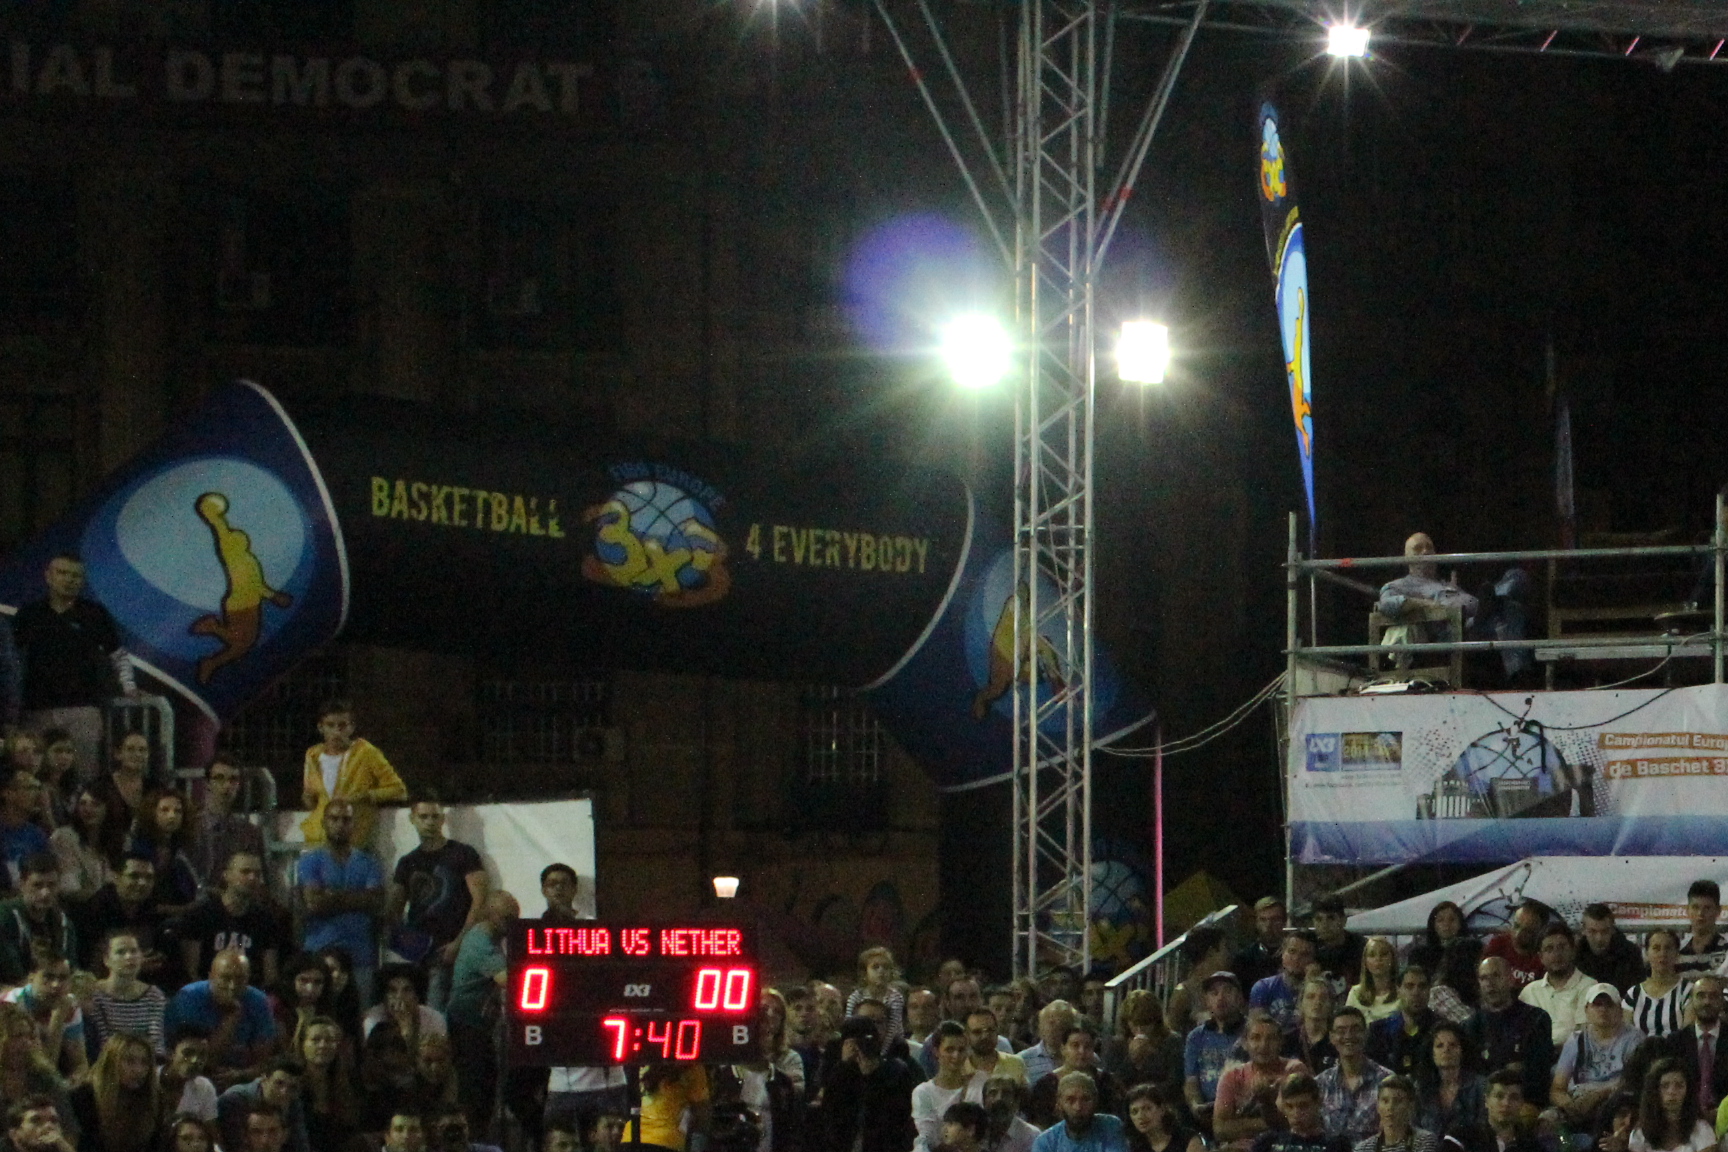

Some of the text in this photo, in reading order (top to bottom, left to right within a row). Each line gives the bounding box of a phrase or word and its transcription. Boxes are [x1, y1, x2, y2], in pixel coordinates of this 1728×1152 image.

[164, 50, 594, 114] DEMOCRAT
[370, 476, 567, 538] BASKETBALL
[745, 522, 930, 574] 4 EVERYBODY
[1604, 733, 1689, 748] Campionatul
[1609, 761, 1632, 777] de
[1637, 759, 1710, 775] Baschet
[527, 928, 743, 956] LITHUA VS NETHER
[521, 967, 549, 1009] 0
[694, 968, 751, 1010] 00
[525, 1025, 543, 1045] B
[603, 1017, 702, 1062] 7:40
[732, 1025, 750, 1045] B
